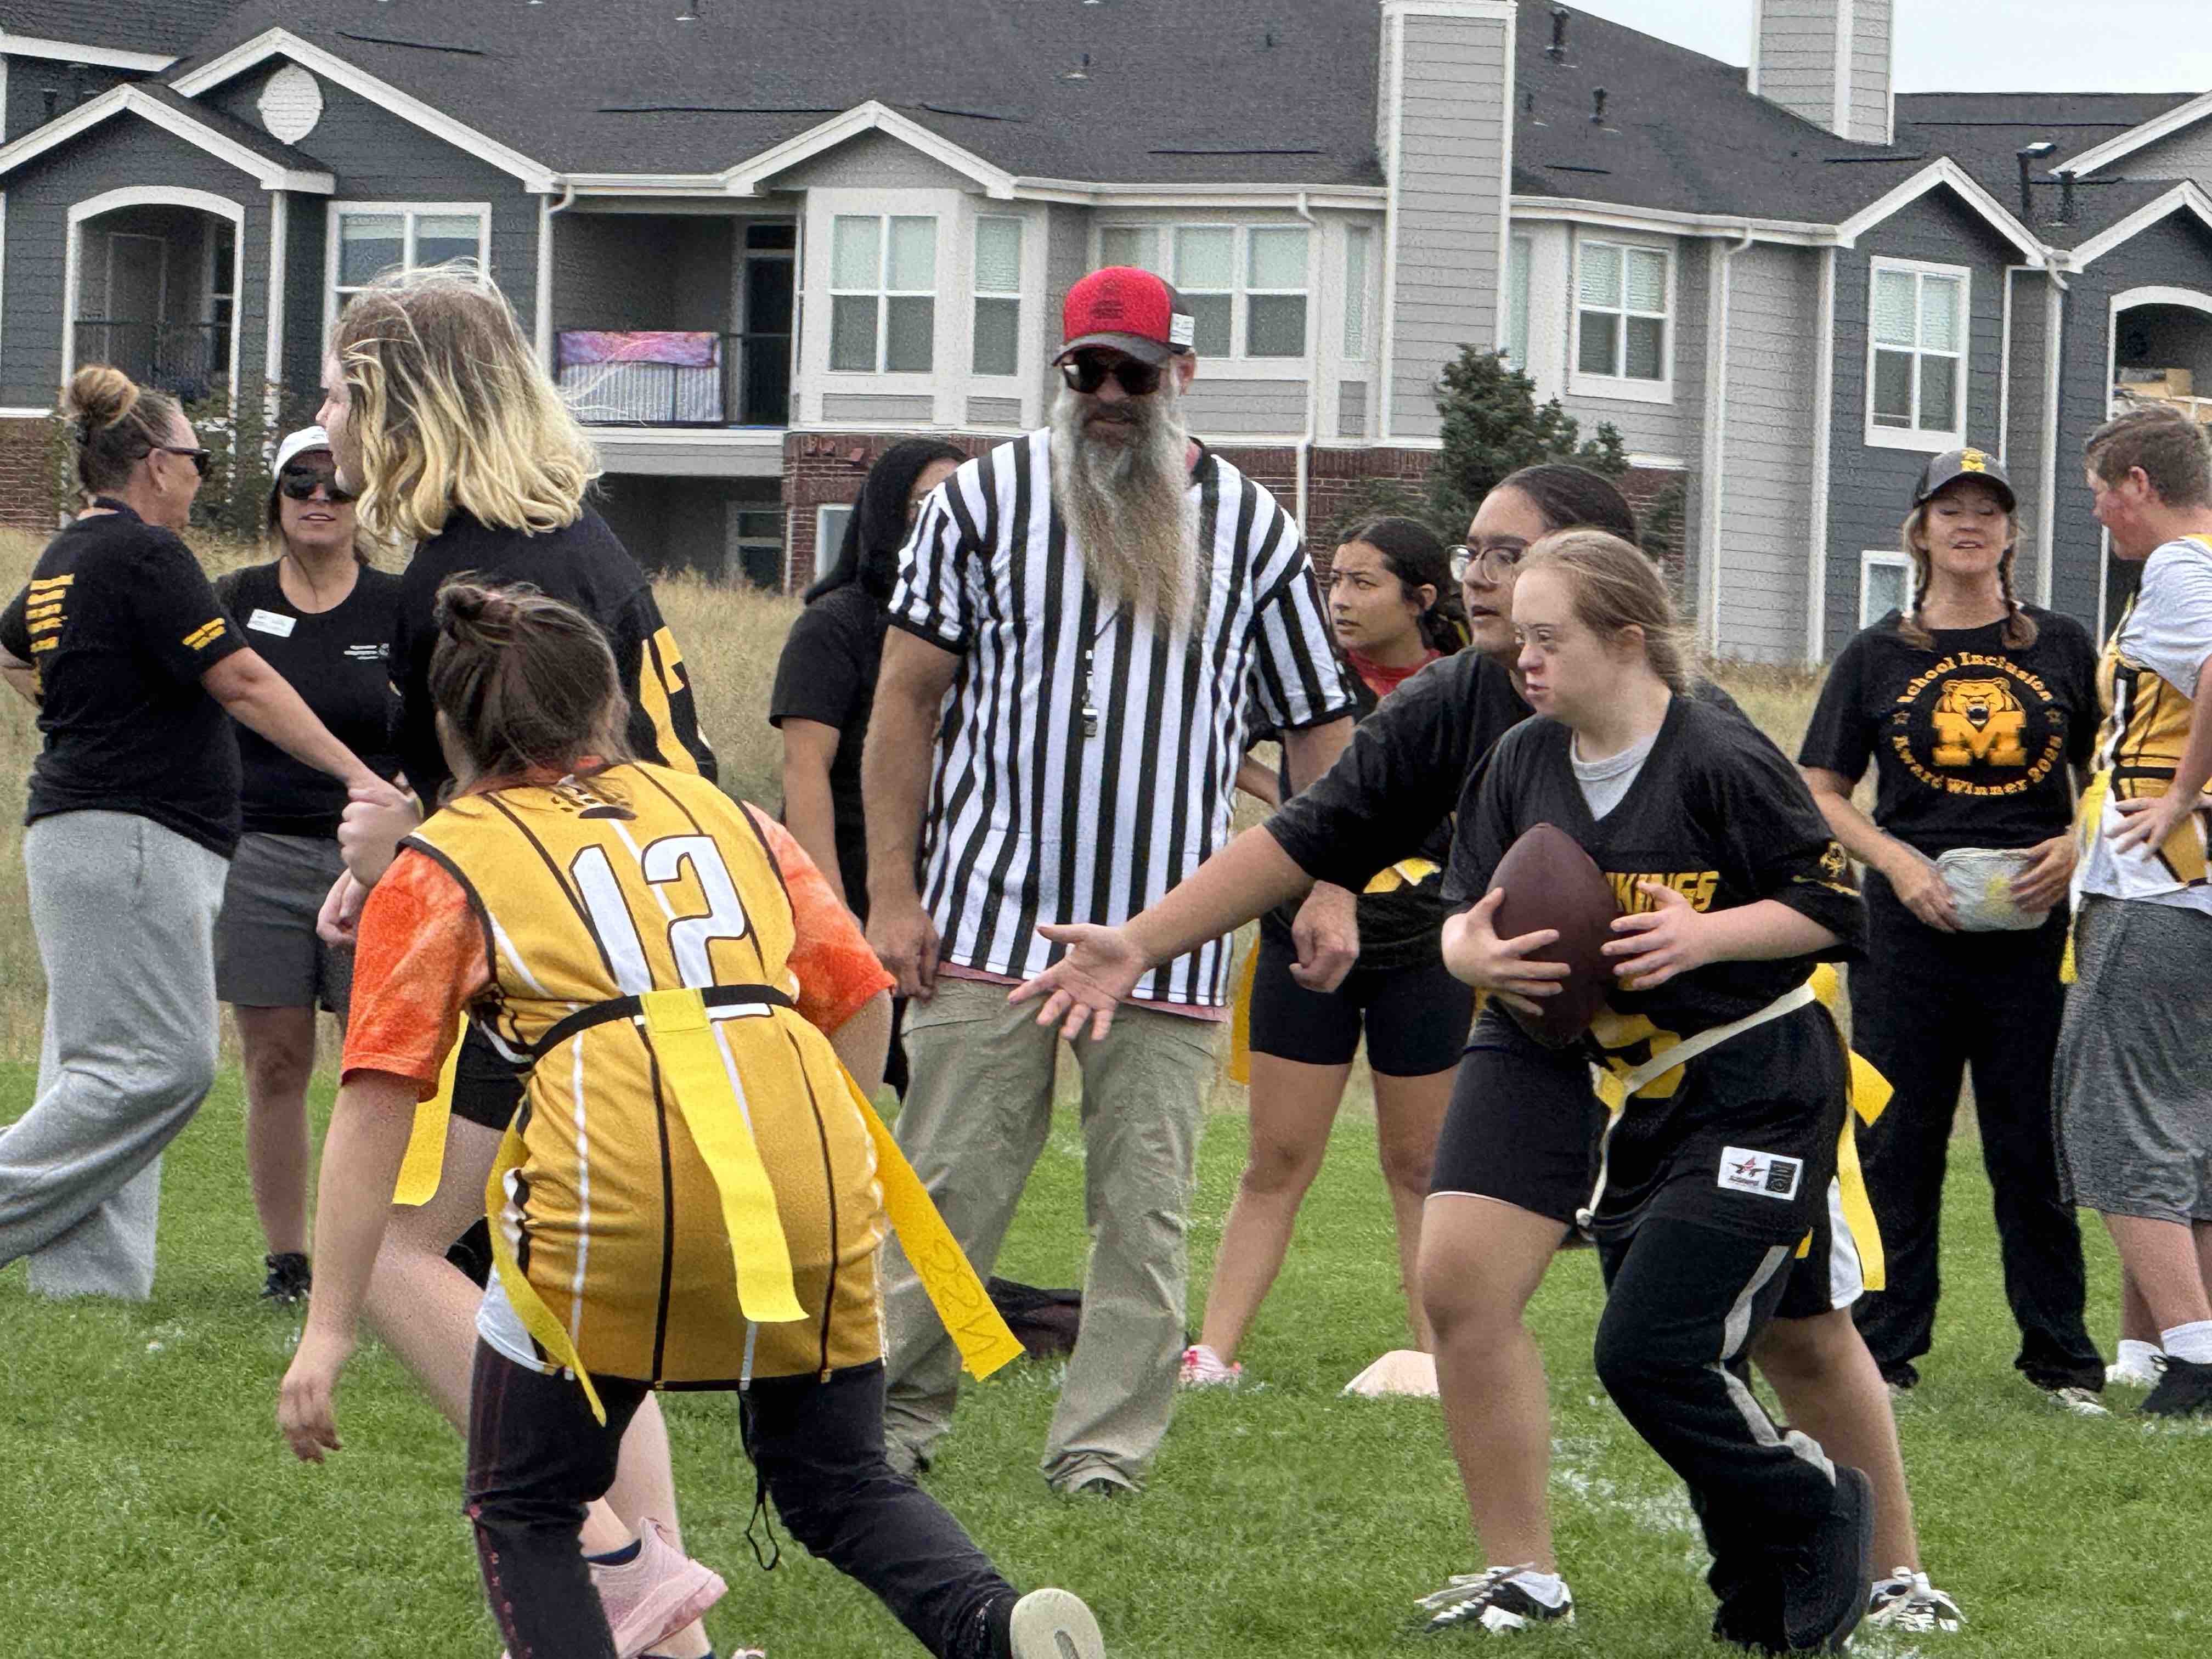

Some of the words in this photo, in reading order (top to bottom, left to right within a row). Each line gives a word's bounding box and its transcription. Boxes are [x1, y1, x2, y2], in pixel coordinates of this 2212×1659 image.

[1932, 710, 2028, 768] M
[1946, 777, 2028, 796] Winner
[568, 834, 774, 1022] 12
